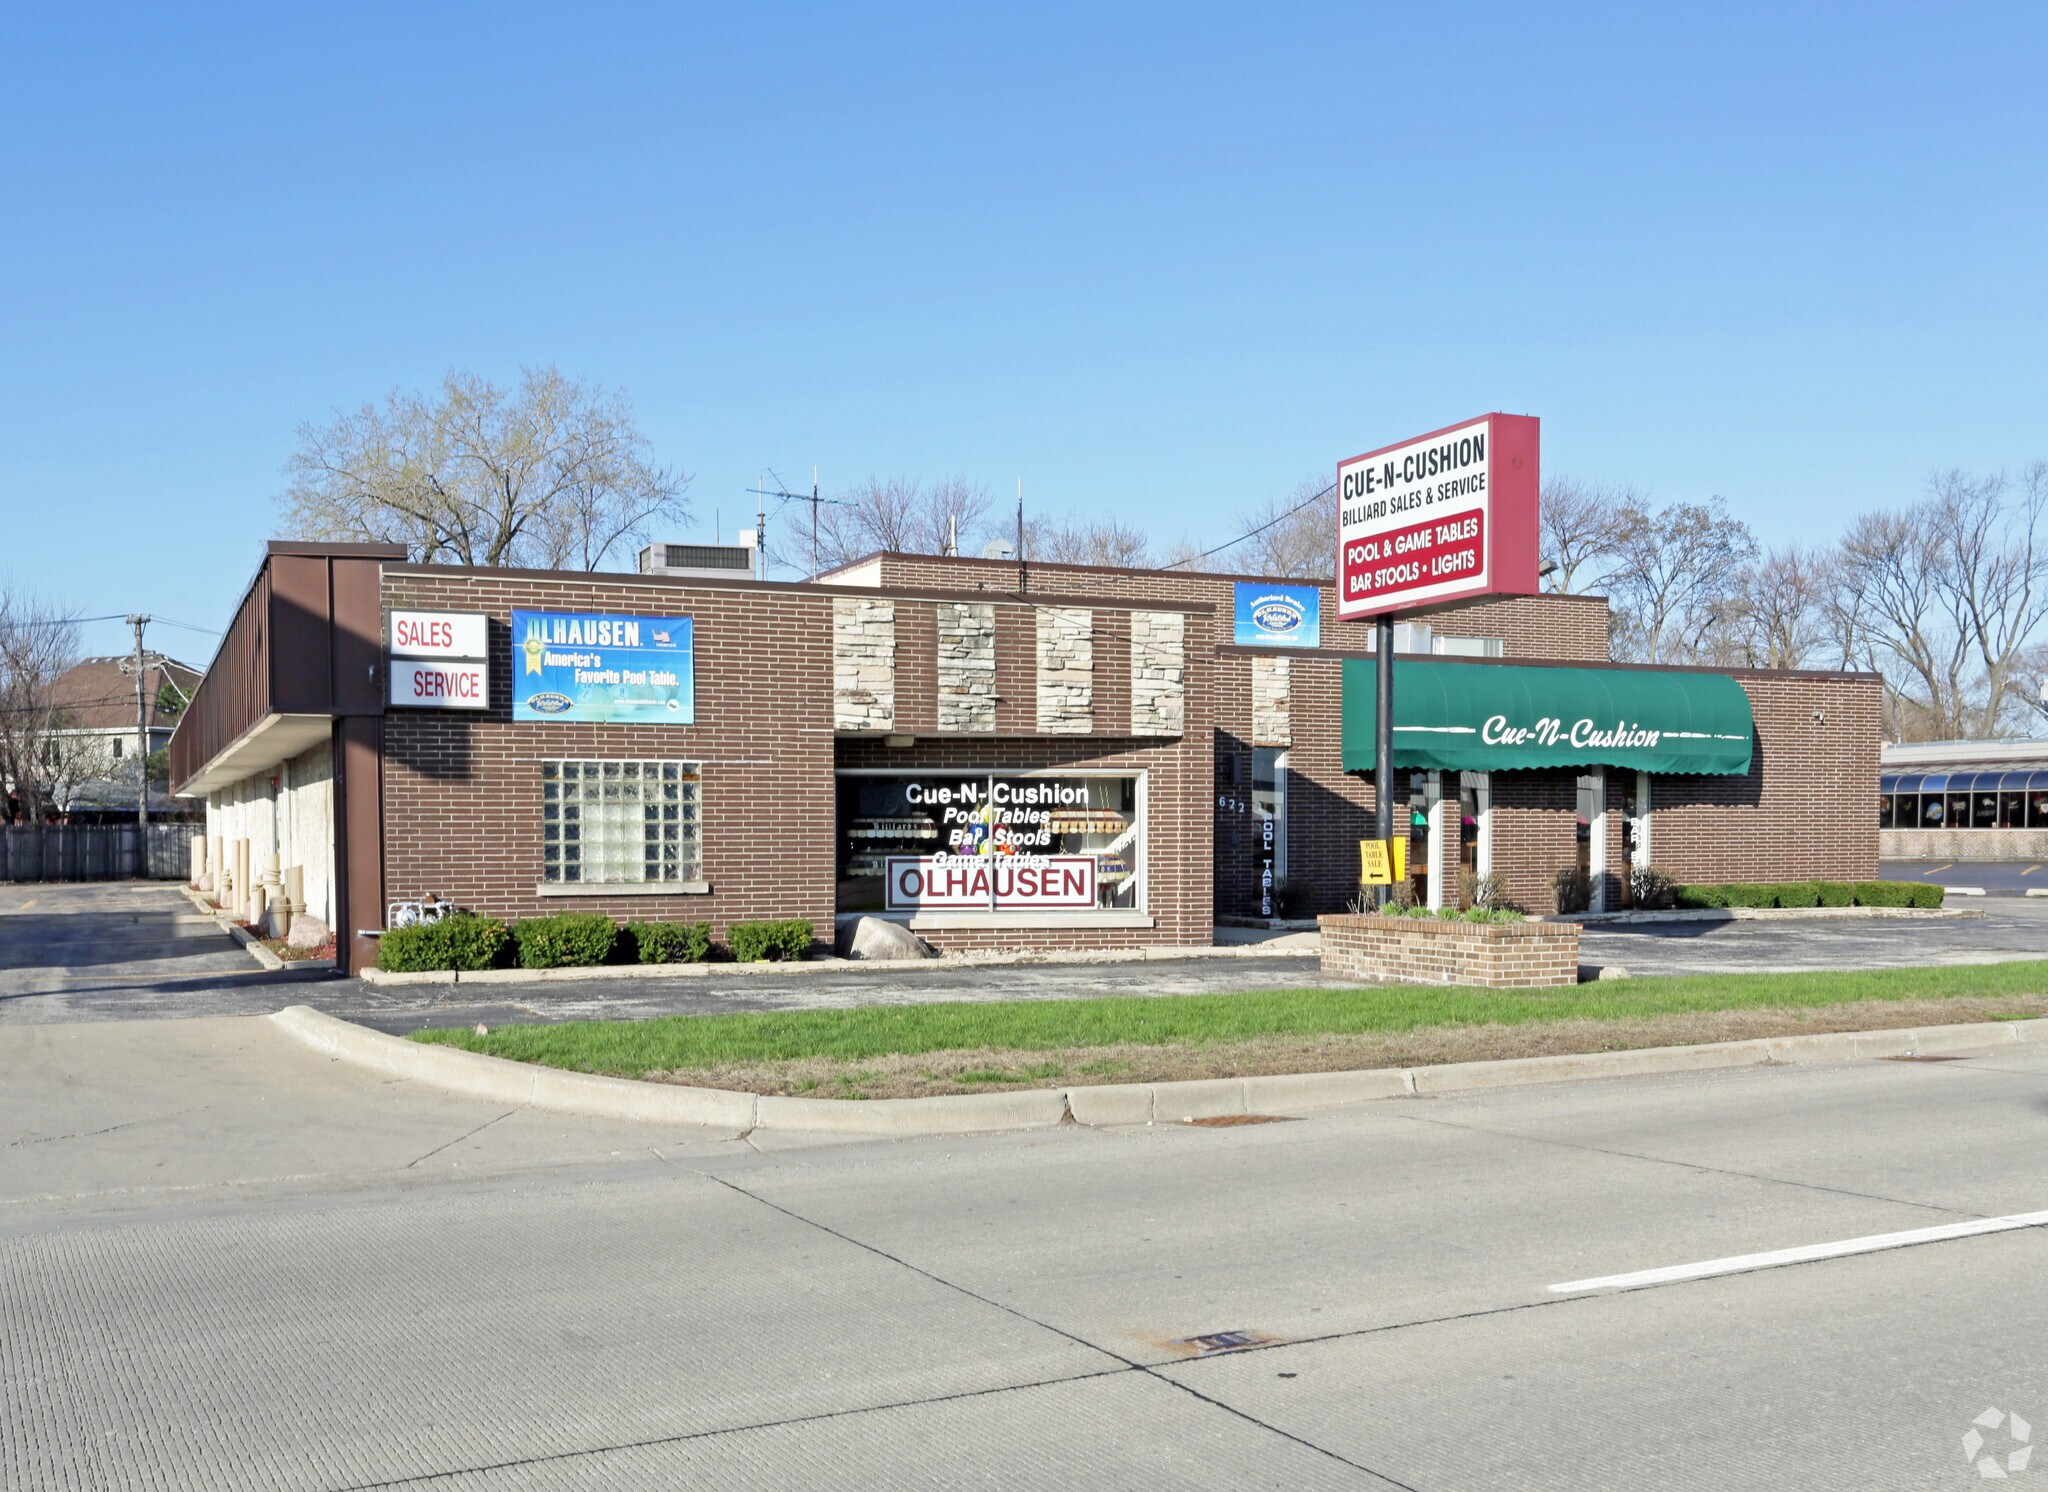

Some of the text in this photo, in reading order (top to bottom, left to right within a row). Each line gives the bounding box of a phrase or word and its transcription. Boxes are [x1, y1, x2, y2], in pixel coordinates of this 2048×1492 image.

[1343, 433, 1485, 501] CUE-N-CUSHION
[1342, 472, 1486, 527] BILLIARD SALES & SERVICE
[1348, 517, 1478, 566] POOL & GAME TABLES
[1350, 549, 1475, 594] BAR STOOLS LIGHTS
[397, 620, 453, 648] SALES
[543, 651, 601, 668] America's
[413, 670, 480, 698] SERVICE
[574, 669, 680, 687] Favorite Pool Table.
[1481, 715, 1661, 748] Cue-N-Cushion
[992, 783, 1089, 804] Cushion
[943, 807, 1050, 824] Pool Tables
[948, 829, 1051, 846] Bar Stools
[1364, 841, 1381, 850] POOL
[932, 851, 1051, 869] Game Tables
[1262, 813, 1273, 915] POOL TABLES
[1364, 850, 1384, 859] TABLE
[1367, 860, 1383, 868] SALE
[898, 868, 1085, 898] OLHAUSEN
